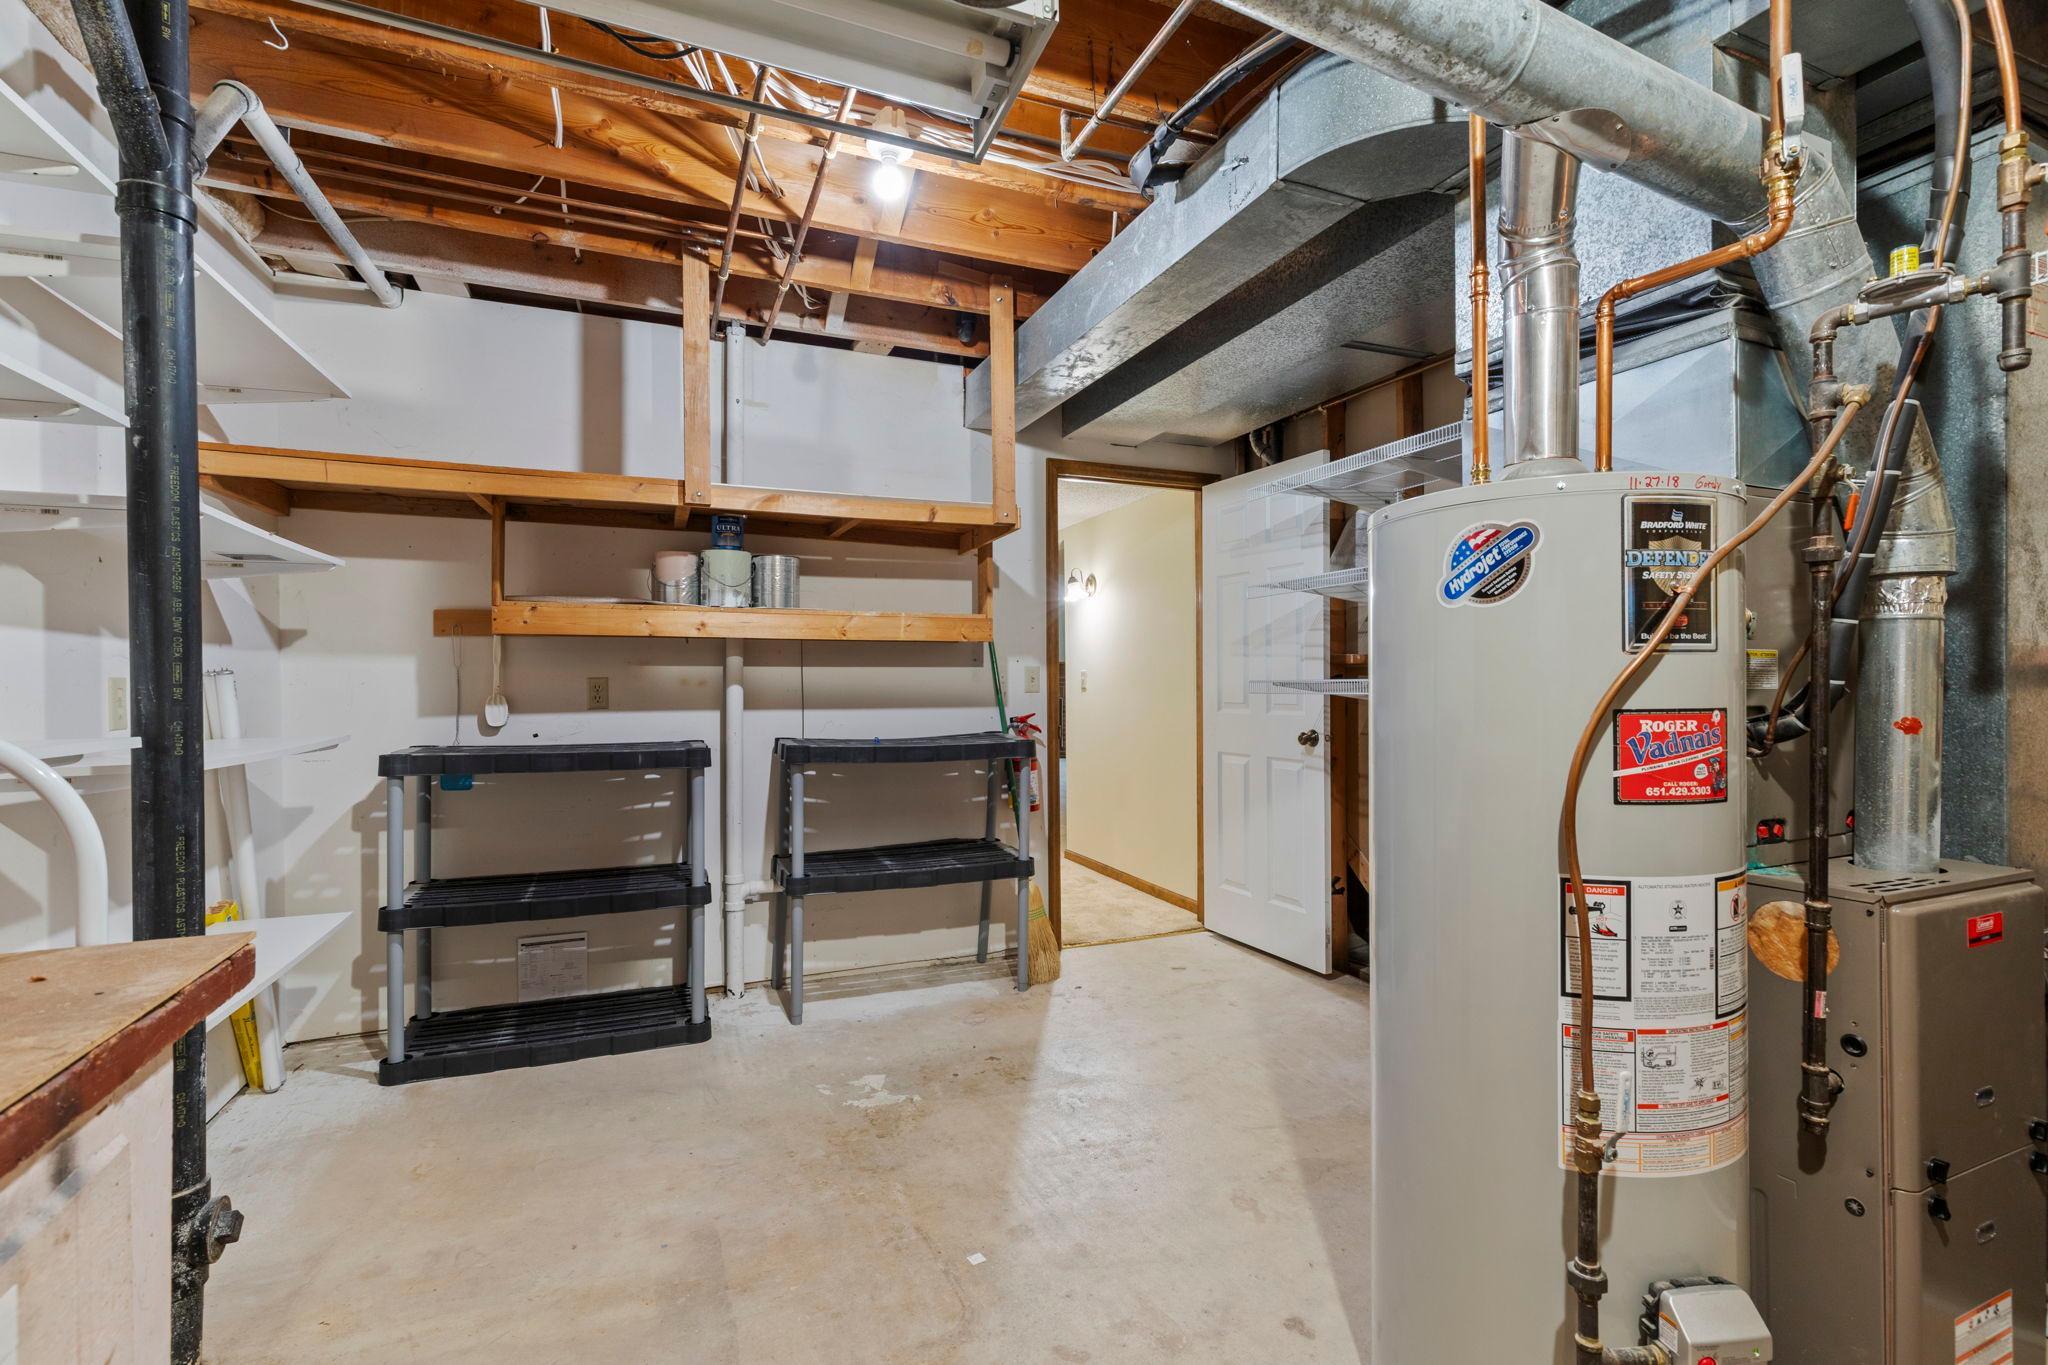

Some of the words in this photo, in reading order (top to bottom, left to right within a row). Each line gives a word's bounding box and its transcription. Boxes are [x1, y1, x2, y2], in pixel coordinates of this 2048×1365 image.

[169, 466, 181, 503] FREEDOM
[170, 506, 181, 543] PLASTICS
[716, 524, 741, 532] ULTRA
[1640, 521, 1684, 530] BRADFORD
[1685, 521, 1708, 531] WHITE
[1501, 530, 1528, 552] PERFORMANCE
[1503, 543, 1519, 556] SYSTEM
[1449, 547, 1502, 595] Hydrojet
[1642, 571, 1675, 580] SAFETY
[1639, 719, 1698, 732] ROGER
[1626, 723, 1722, 765] Vadnais
[1641, 763, 1664, 772] PLUMBING
[1667, 759, 1681, 767] DRAIN
[1645, 786, 1711, 797] 651.429.3303
[175, 836, 186, 874] FREEDOM
[176, 877, 187, 914] PLASTICS
[1586, 887, 1619, 895] DANGER
